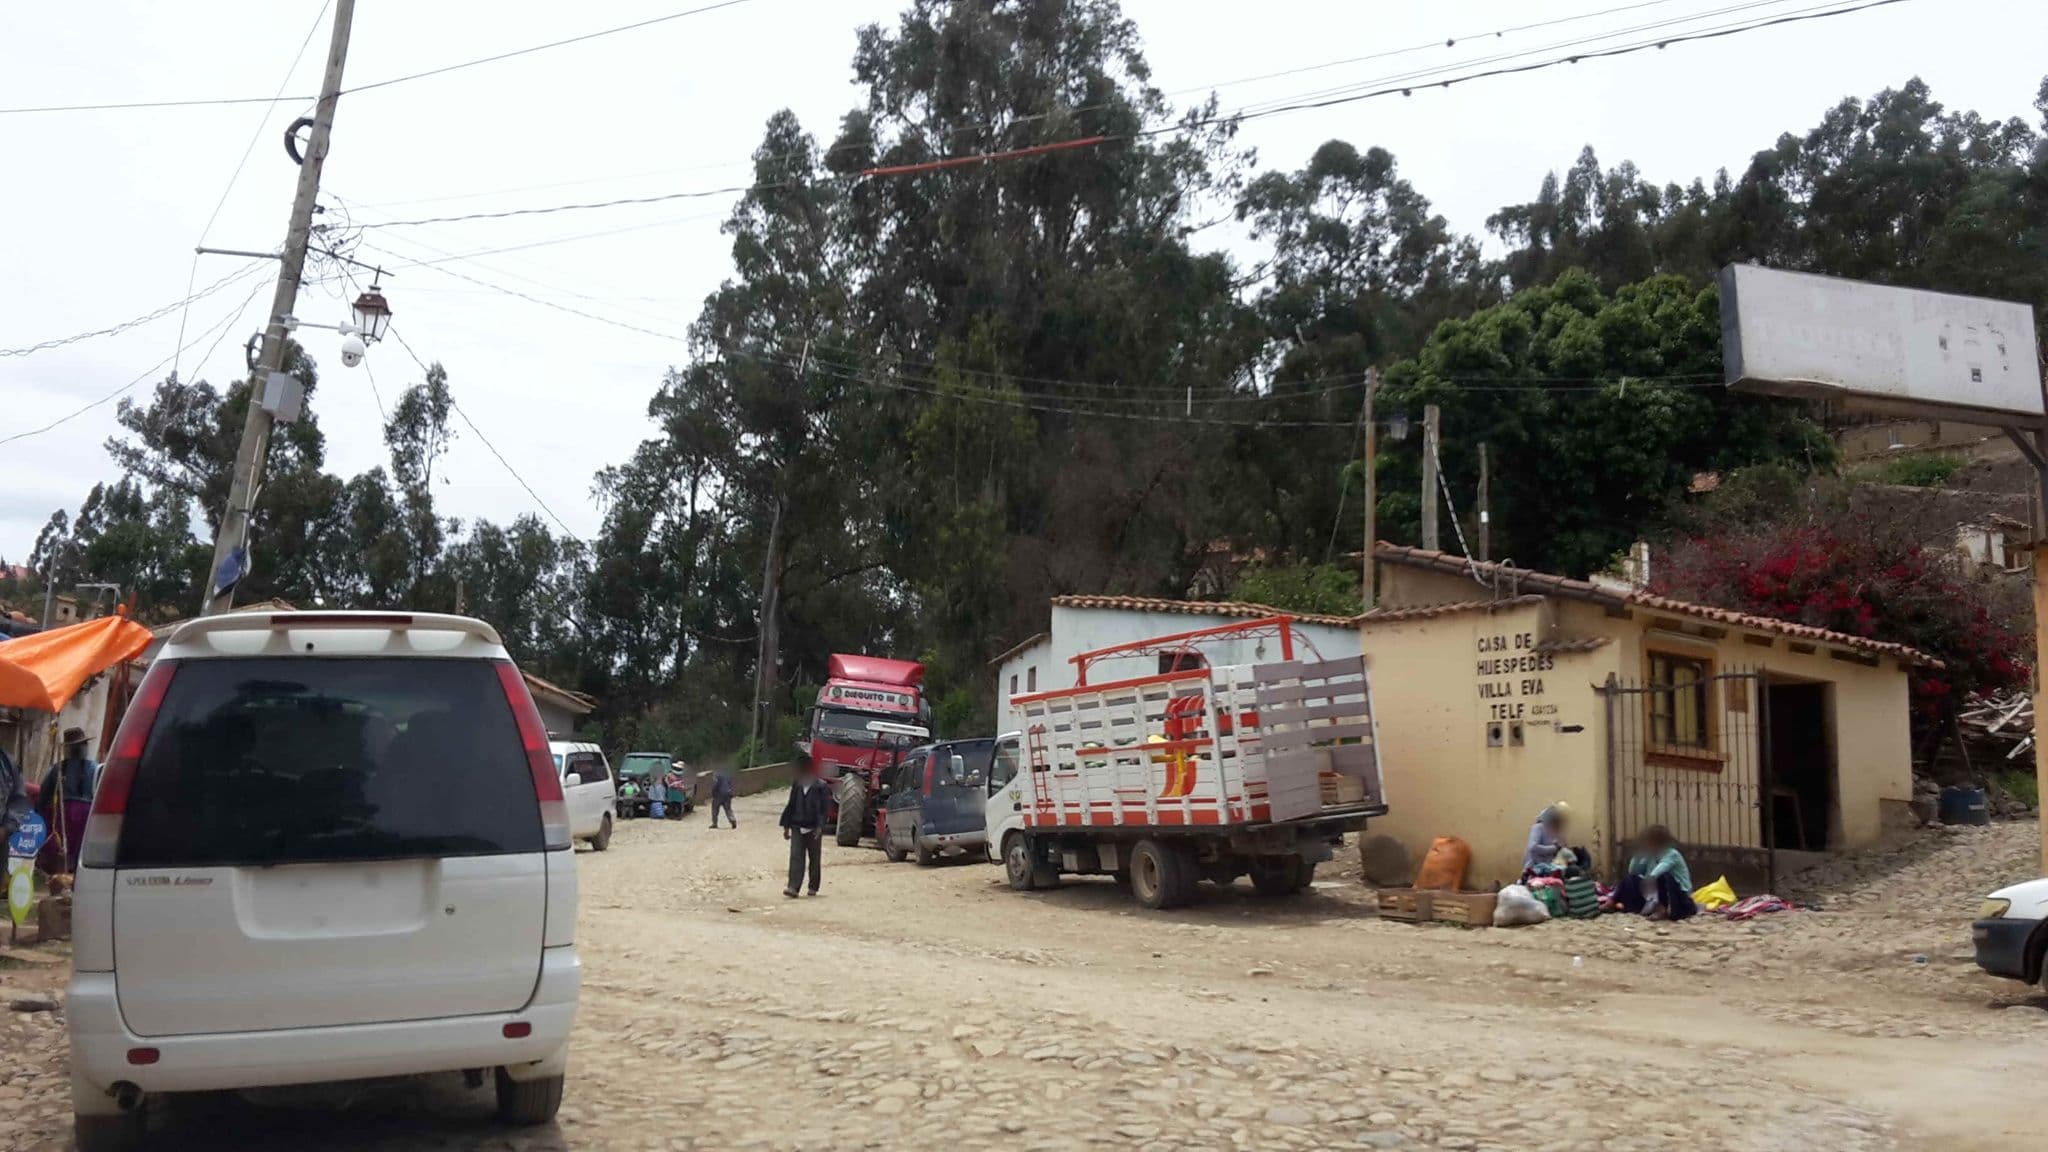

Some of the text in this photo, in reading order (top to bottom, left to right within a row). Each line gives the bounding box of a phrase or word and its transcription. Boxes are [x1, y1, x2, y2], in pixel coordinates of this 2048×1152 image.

[1478, 633, 1531, 652] CASA DE
[1477, 655, 1553, 675] HUESPEDES
[1478, 678, 1544, 698] VILLA EVA
[1490, 703, 1524, 719] TELF
